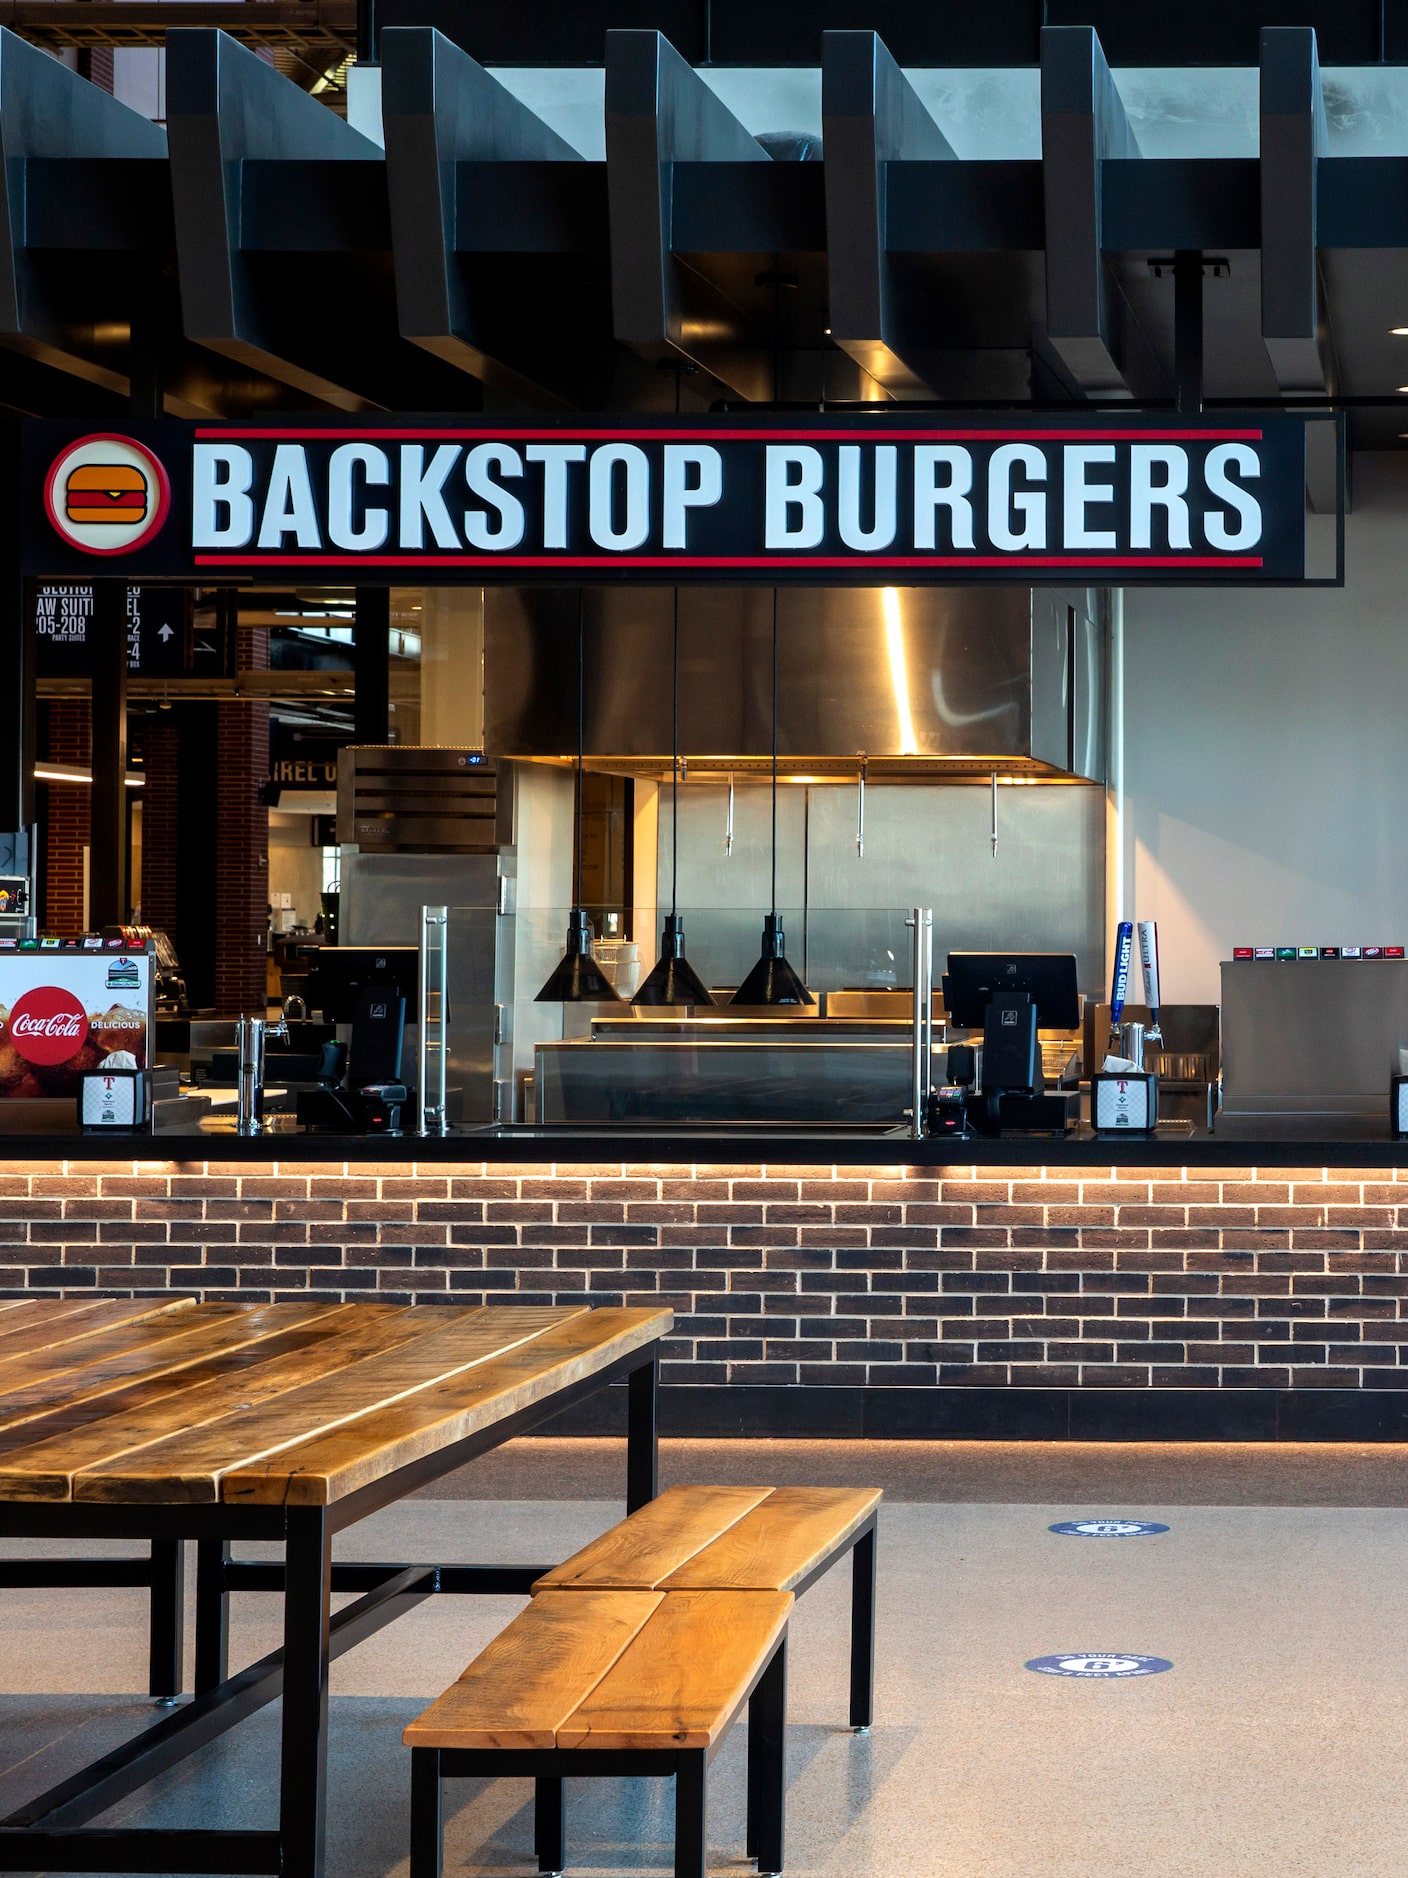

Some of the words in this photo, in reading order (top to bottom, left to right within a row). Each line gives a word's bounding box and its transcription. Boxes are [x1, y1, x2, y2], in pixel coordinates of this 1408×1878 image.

[192, 442, 723, 551] BACKSTOP
[765, 442, 1263, 551] BURGERS
[61, 598, 94, 616] SUIT
[36, 616, 86, 634] 05-208
[1119, 936, 1131, 973] LIGHT
[1141, 929, 1150, 963] ULTRA
[1116, 974, 1127, 1001] BUD
[12, 1013, 85, 1037] Coca-Cola
[91, 1021, 141, 1029] DELICIOUS
[103, 1076, 115, 1090] T
[1116, 1080, 1129, 1094] T
